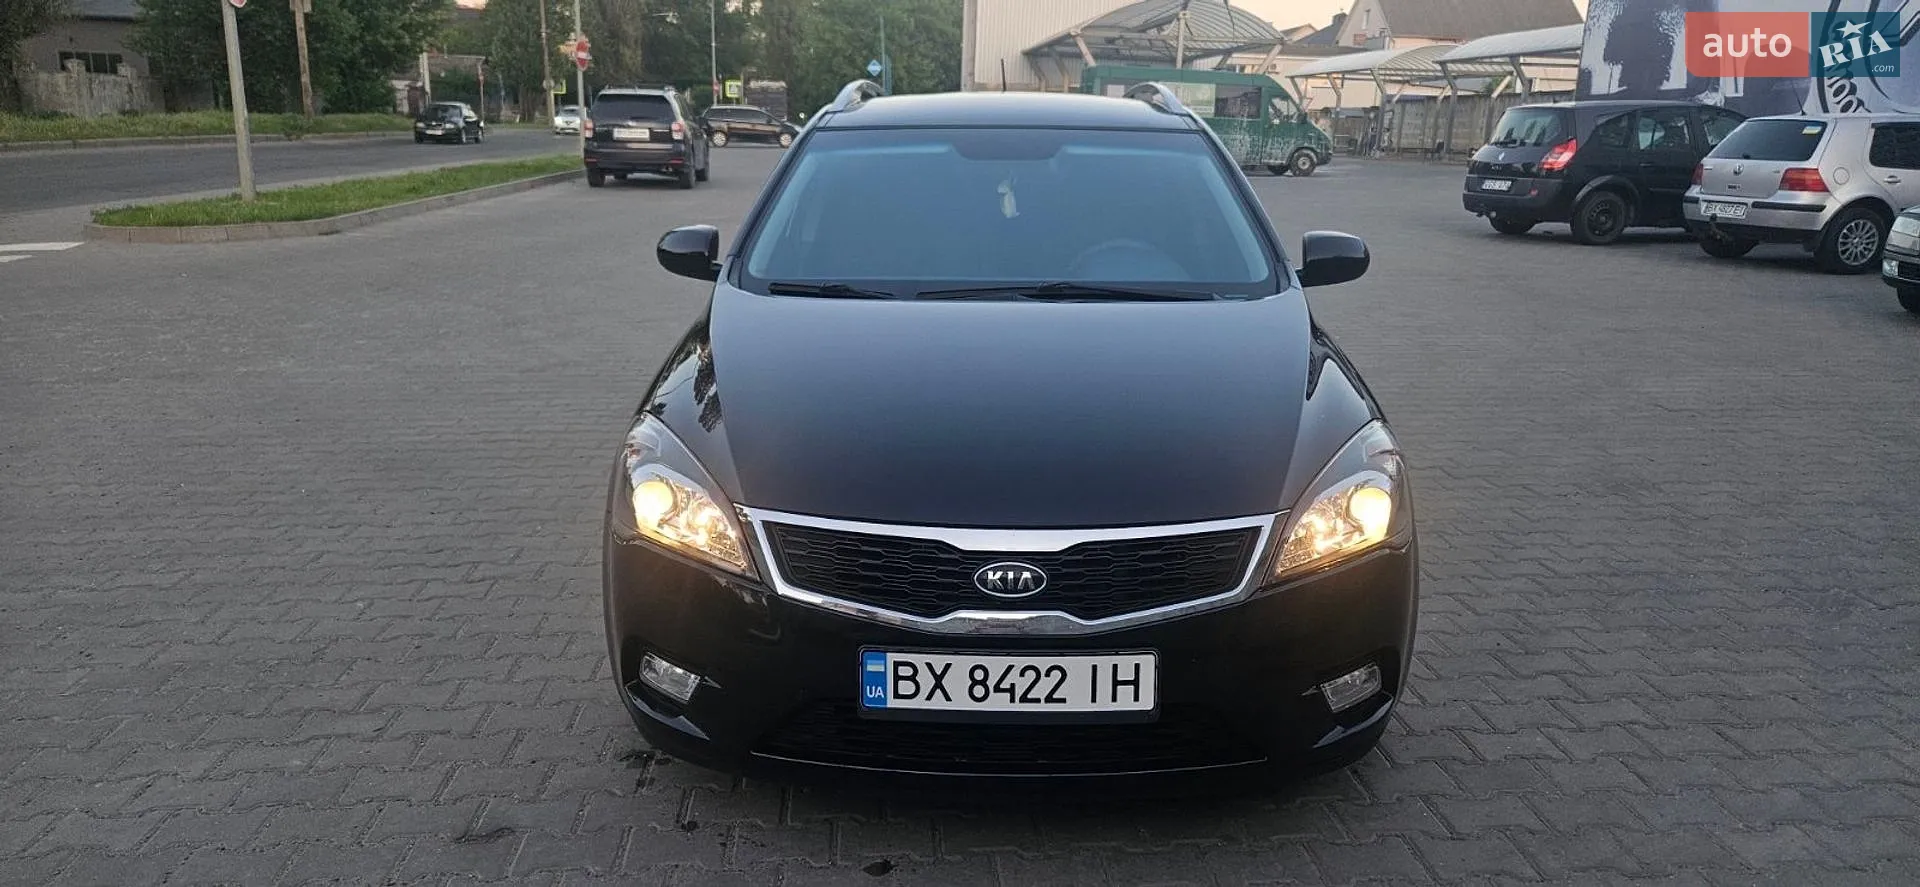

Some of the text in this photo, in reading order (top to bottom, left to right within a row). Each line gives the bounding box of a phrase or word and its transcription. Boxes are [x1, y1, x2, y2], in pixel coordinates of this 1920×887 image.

[987, 570, 1035, 590] KIA
[866, 685, 885, 699] UA
[892, 660, 1140, 704] BX 8422 IH
